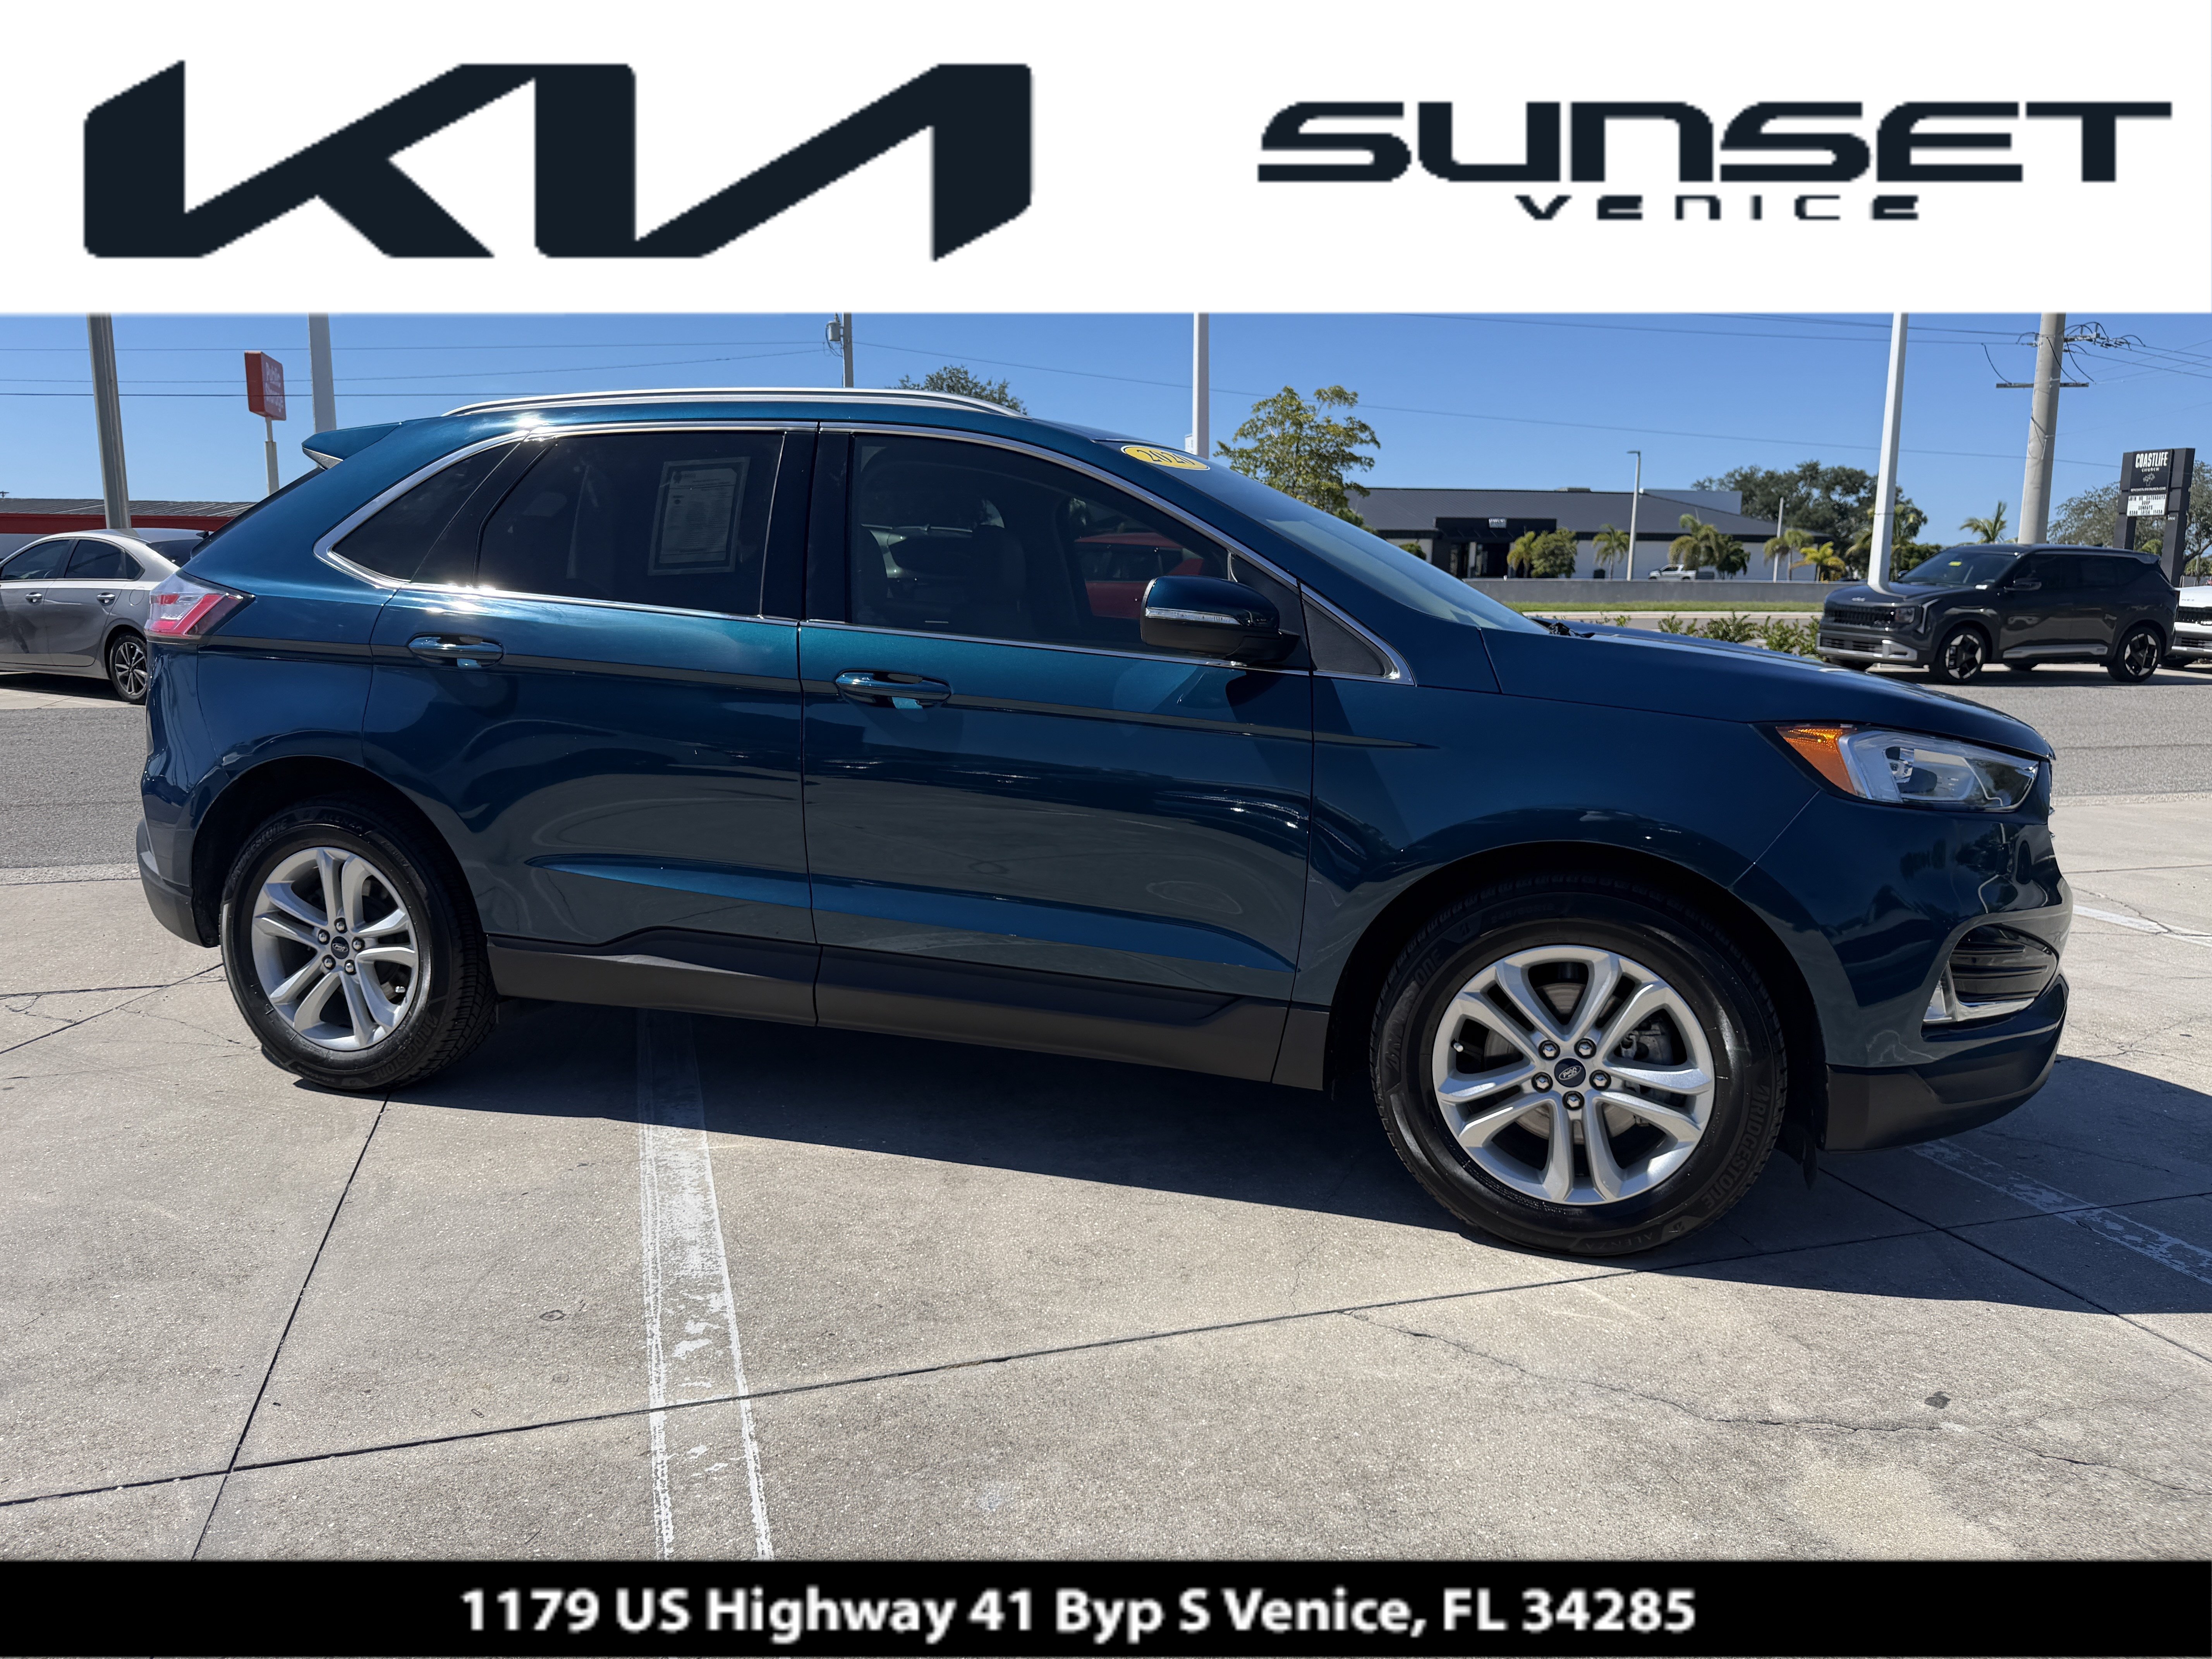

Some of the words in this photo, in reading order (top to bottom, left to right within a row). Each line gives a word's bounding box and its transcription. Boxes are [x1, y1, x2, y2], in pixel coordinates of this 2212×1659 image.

[2135, 452, 2169, 468] COASTLIFE
[1701, 1084, 1770, 1209] BRIDGESTONE
[1585, 1232, 1652, 1250] ALENZA
